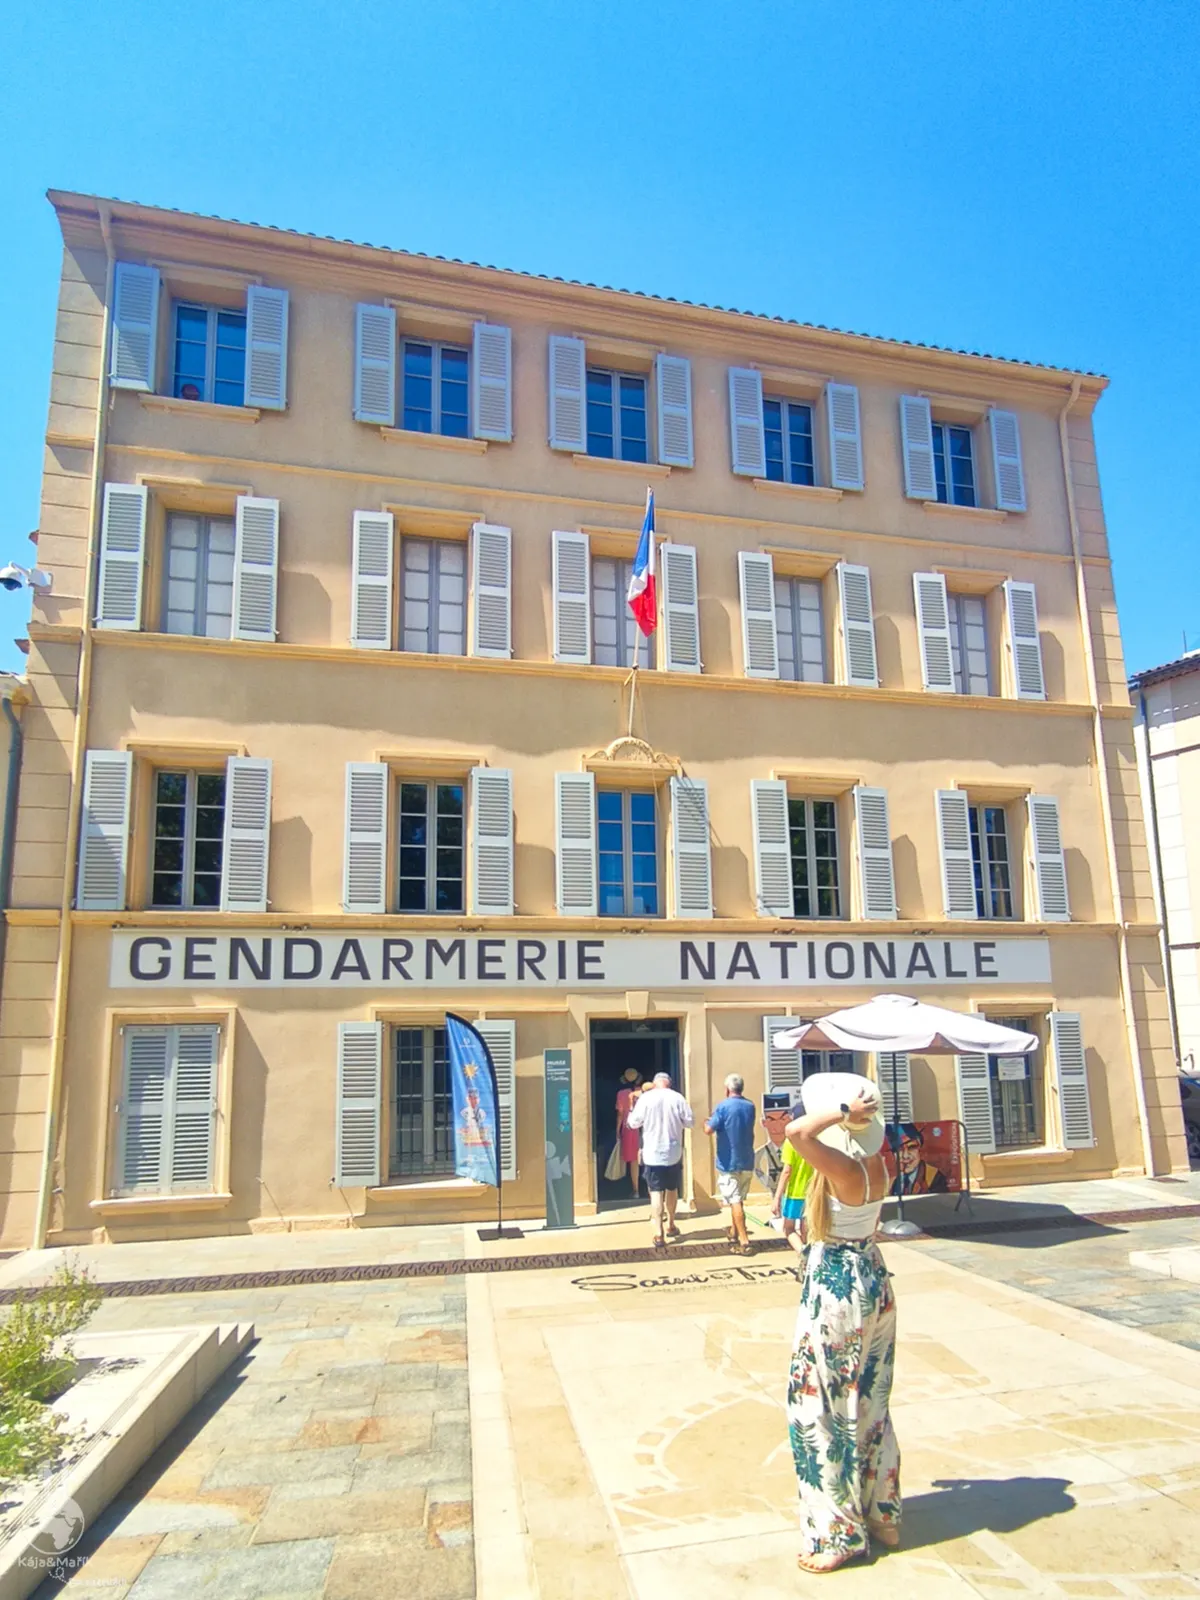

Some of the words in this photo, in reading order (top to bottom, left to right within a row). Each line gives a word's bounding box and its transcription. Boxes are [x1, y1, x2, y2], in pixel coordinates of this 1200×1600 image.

[130, 937, 605, 981] GENDARMERIE
[680, 941, 999, 980] NATIONALE
[571, 1274, 708, 1291] Saint
